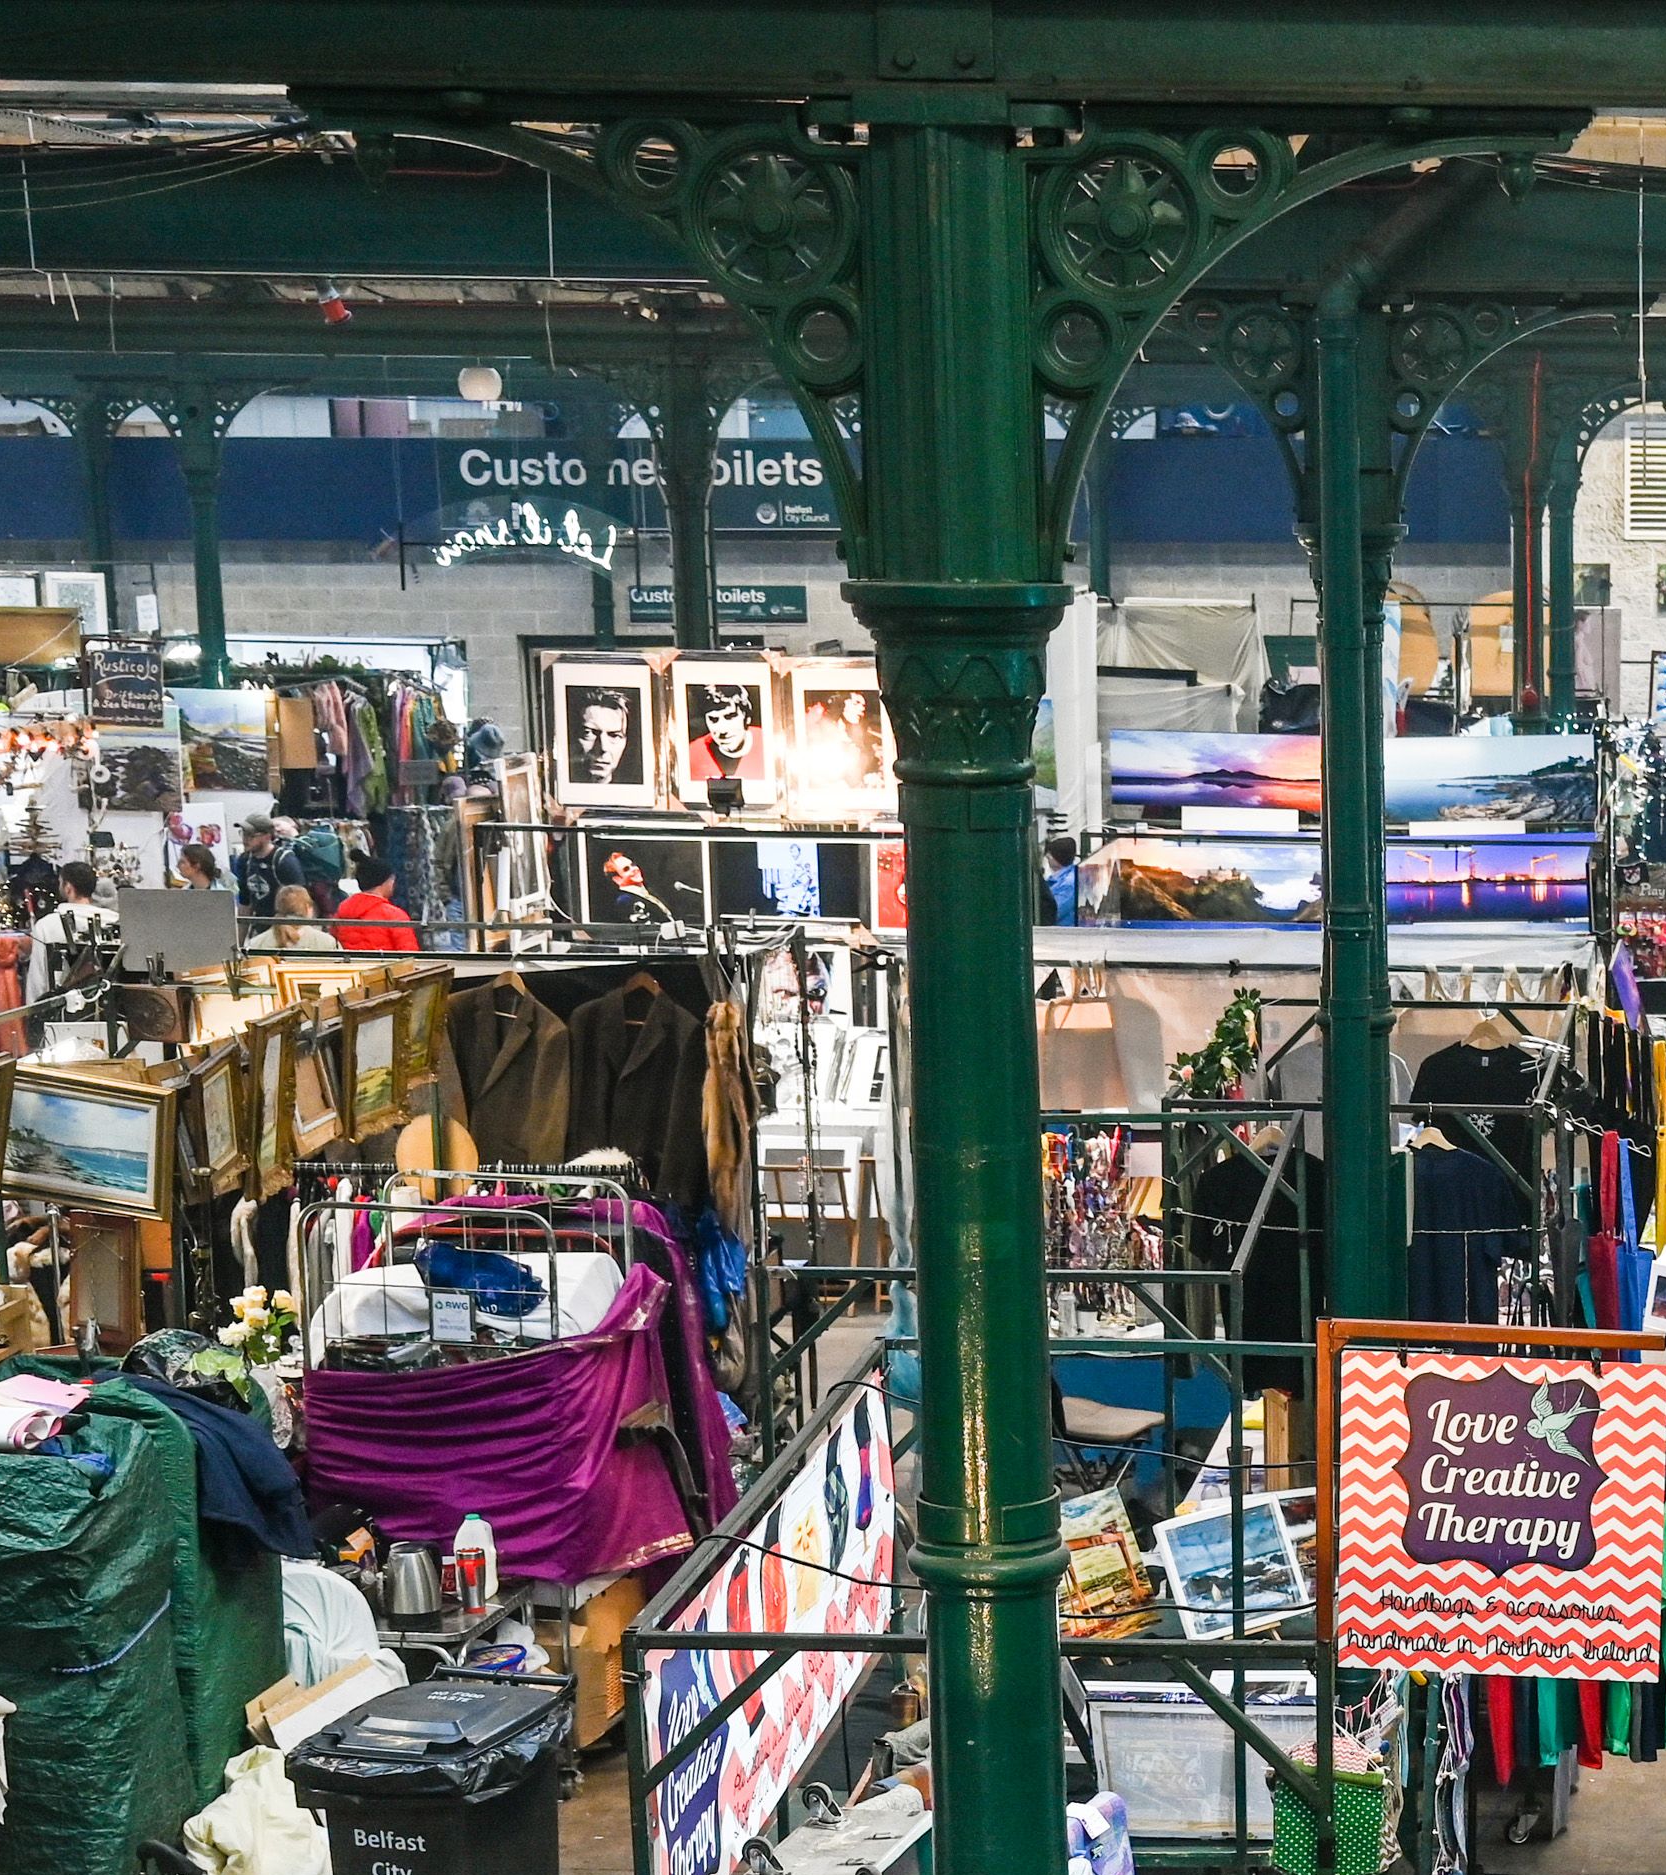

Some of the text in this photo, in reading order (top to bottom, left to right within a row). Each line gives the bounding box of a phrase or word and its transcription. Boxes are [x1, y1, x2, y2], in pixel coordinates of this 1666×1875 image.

[712, 449, 824, 487] oilets
[716, 590, 767, 603] toilets
[1427, 1399, 1518, 1456] Love
[1421, 1452, 1581, 1500] Creative
[1417, 1502, 1582, 1560] Therapy
[1380, 1589, 1478, 1617] Handbags
[1486, 1595, 1498, 1612] &
[1347, 1628, 1656, 1664] handmade in Northern Ireland
[427, 1694, 472, 1702] WASTE
[452, 1691, 486, 1699] FOOD
[666, 1677, 702, 1751] Love
[667, 1736, 724, 1832] Creative
[353, 1829, 427, 1852] Belfast
